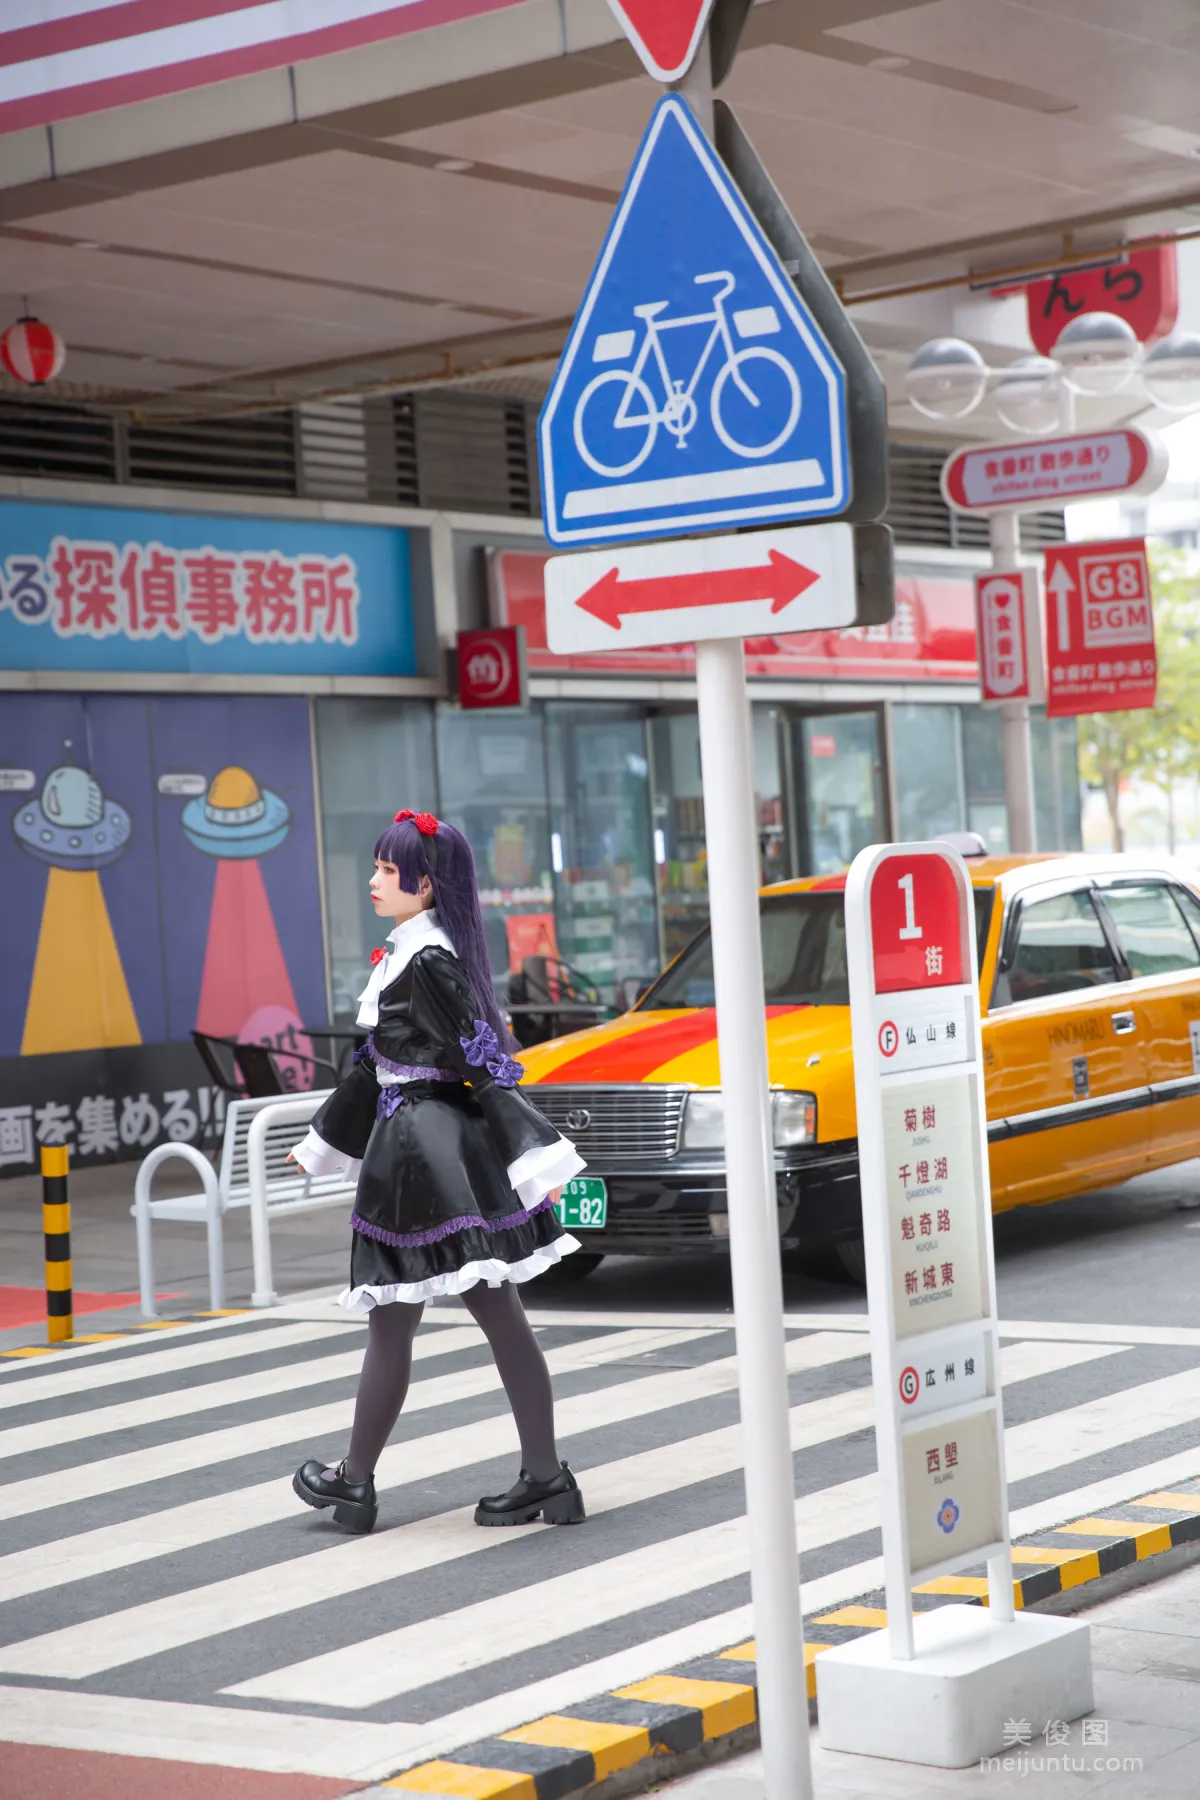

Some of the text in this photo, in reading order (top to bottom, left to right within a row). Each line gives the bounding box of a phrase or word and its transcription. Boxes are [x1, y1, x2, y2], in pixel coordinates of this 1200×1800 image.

[1088, 564, 1140, 599] G8
[1087, 604, 1147, 631] BGM
[897, 873, 923, 941] 1
[925, 946, 944, 976] 街
[905, 1021, 957, 1046] 仏山線
[904, 1104, 936, 1133] 菊樹
[898, 1156, 948, 1188] 千燈湖
[901, 1208, 951, 1240] 魁奇路
[904, 1261, 955, 1296] 新城東
[925, 1357, 976, 1388] 広州線
